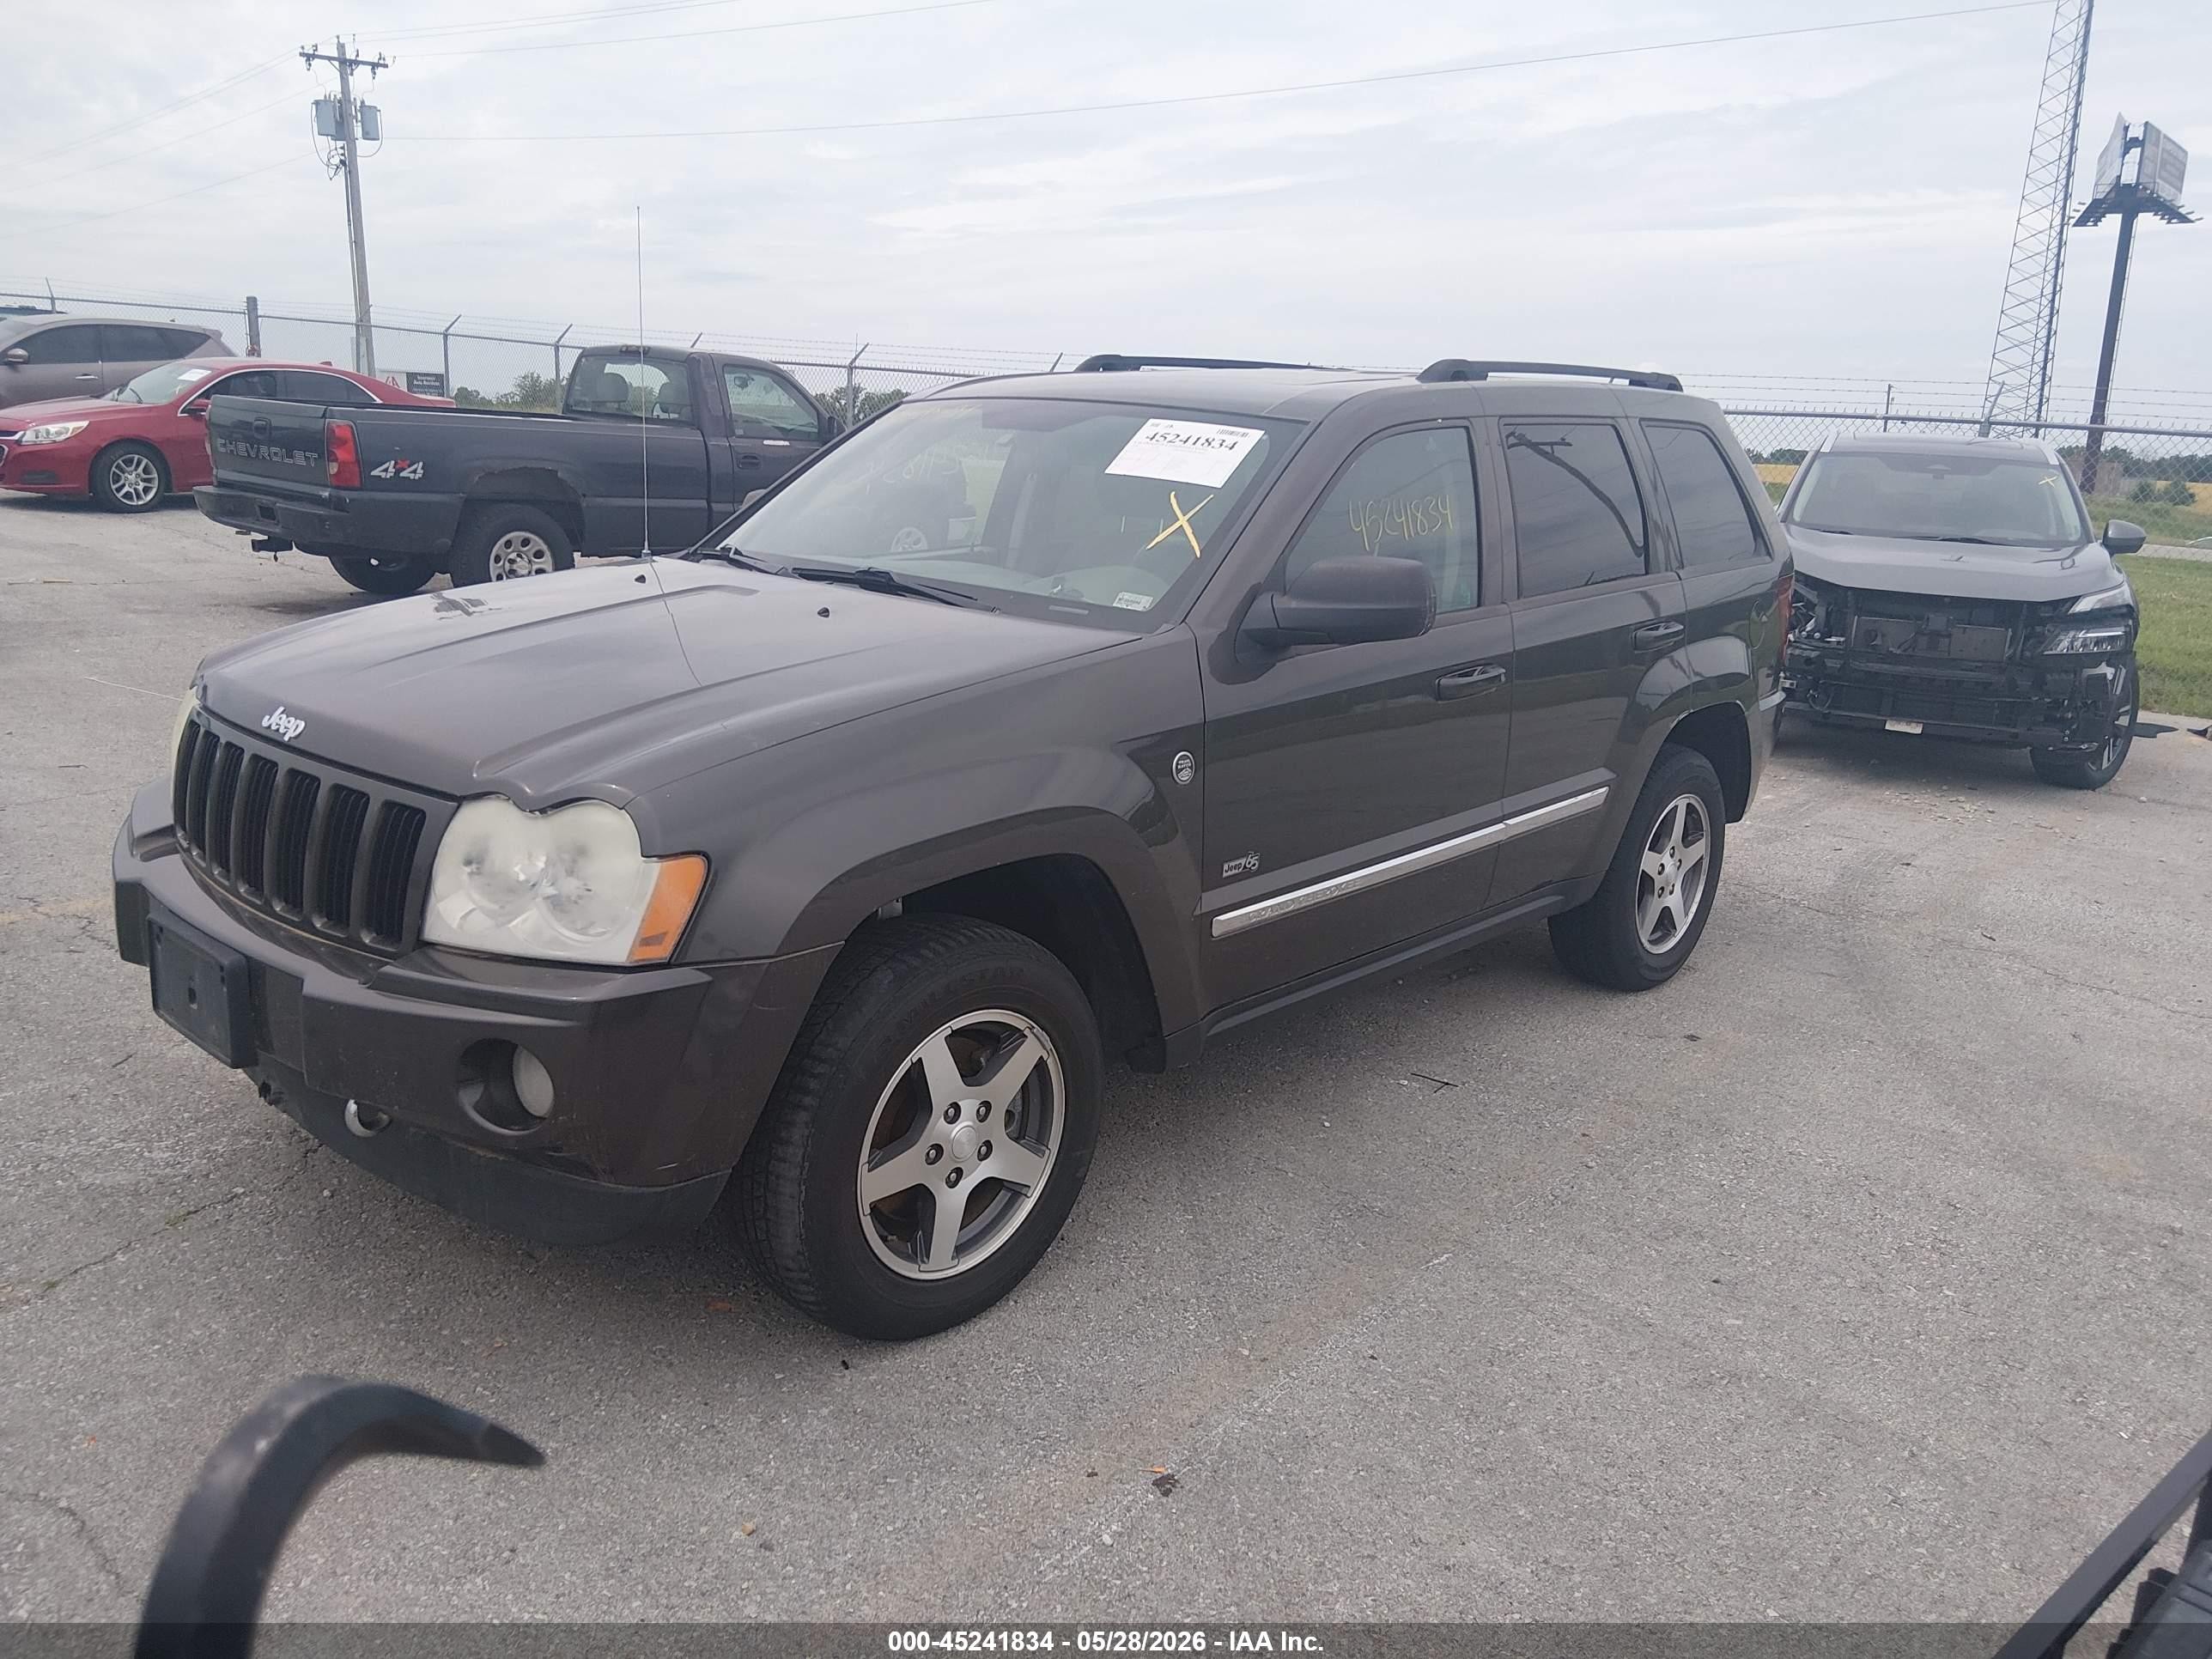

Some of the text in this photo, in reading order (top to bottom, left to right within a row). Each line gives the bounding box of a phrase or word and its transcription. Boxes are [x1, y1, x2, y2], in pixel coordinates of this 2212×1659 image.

[217, 439, 319, 468] CHEVROLET
[1146, 430, 1239, 452] 45241834
[1348, 494, 1454, 551] 45241834
[261, 706, 306, 742] Jeep
